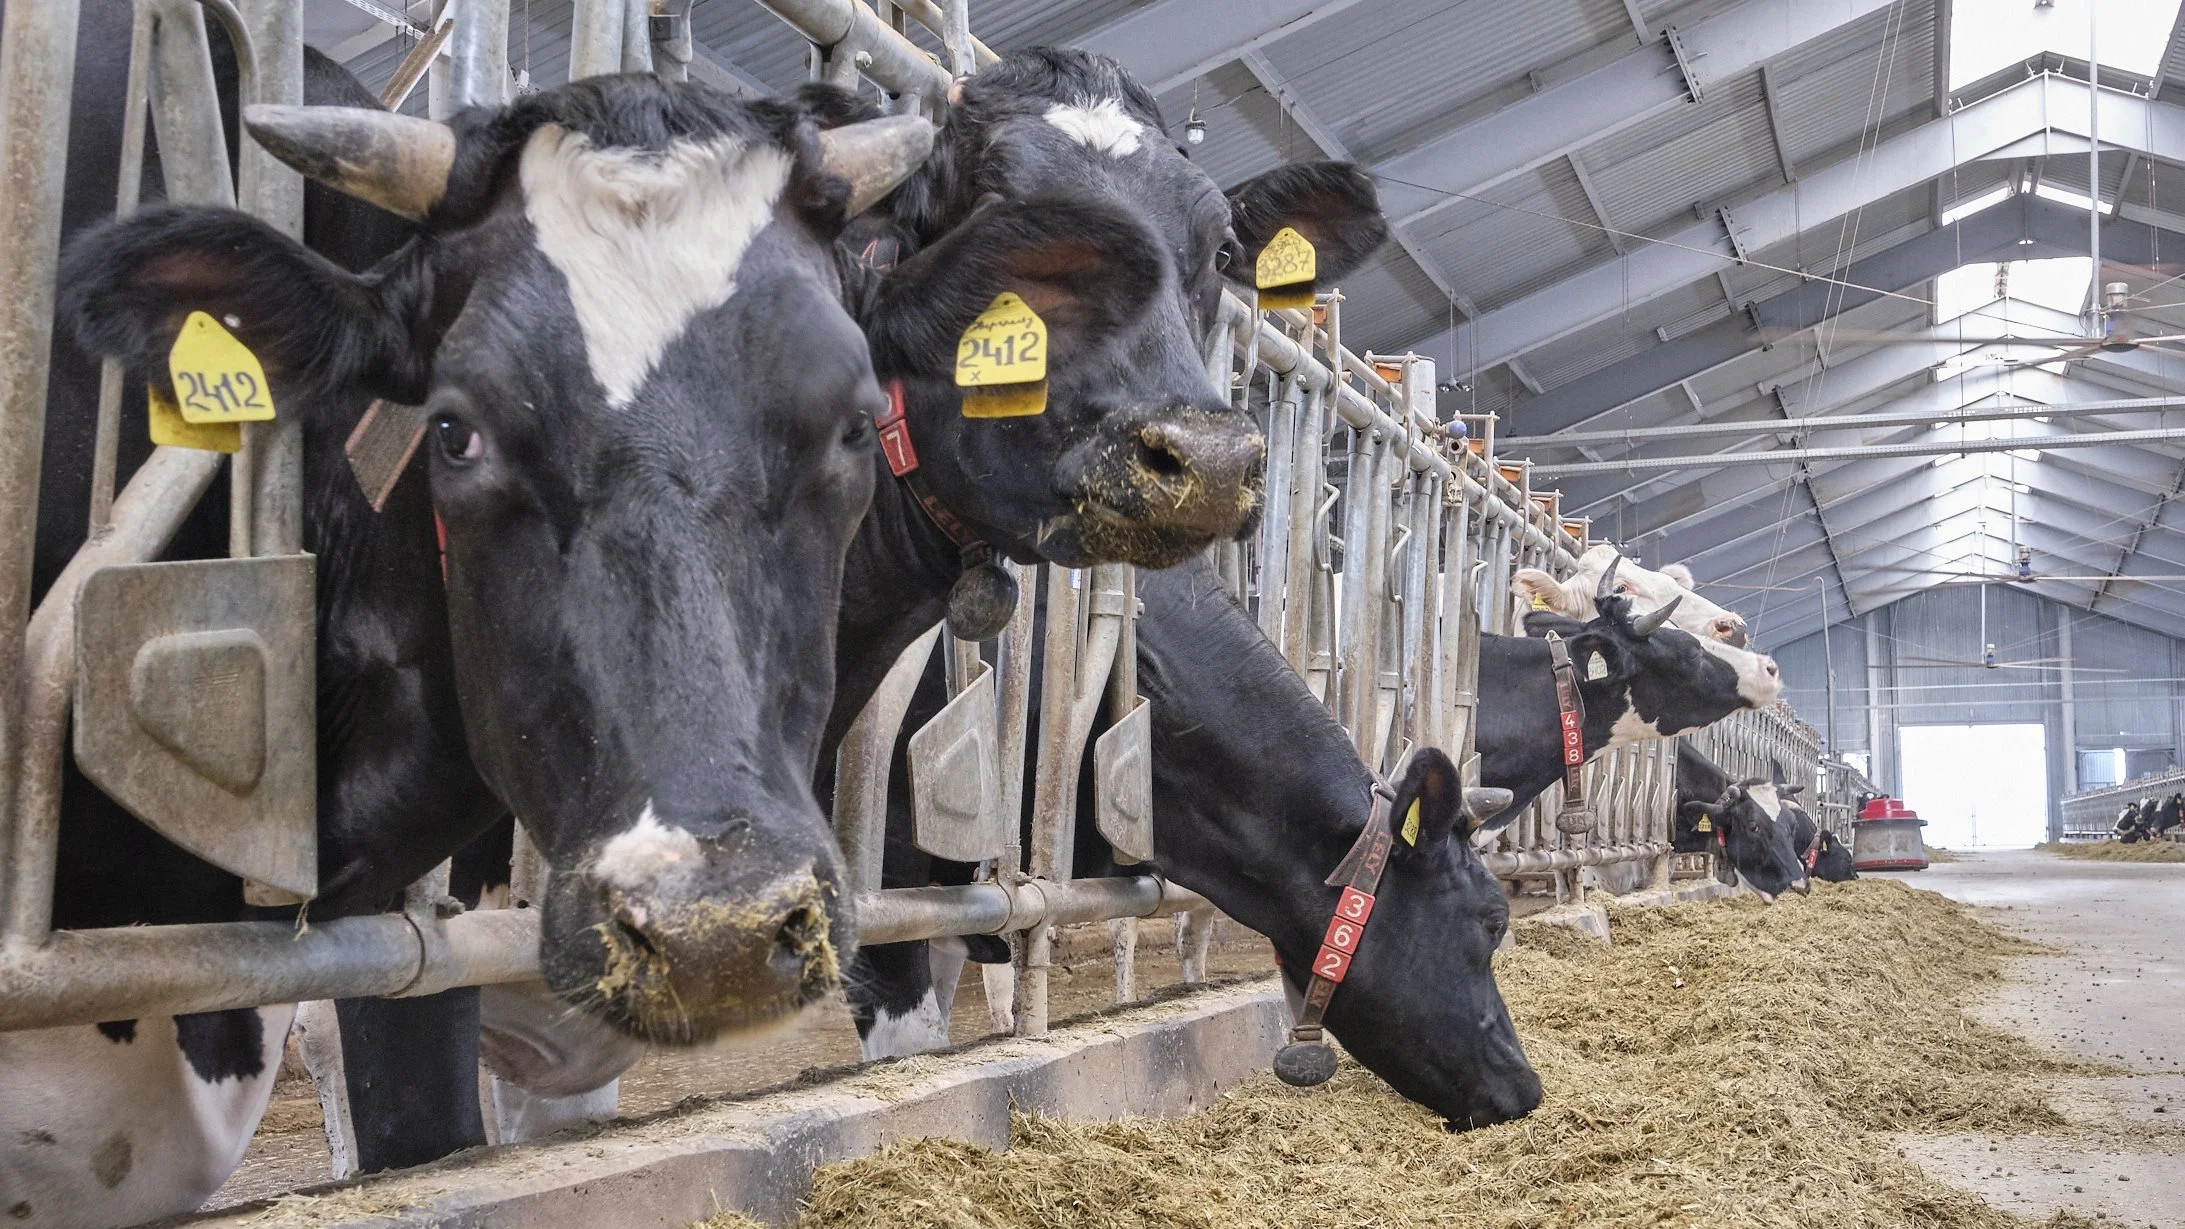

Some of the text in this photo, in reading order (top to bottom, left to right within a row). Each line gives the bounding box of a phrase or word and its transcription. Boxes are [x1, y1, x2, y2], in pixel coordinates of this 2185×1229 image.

[959, 331, 1040, 369] 2412
[178, 371, 265, 412] 2412
[1565, 714, 1579, 762] 438
[1321, 894, 1365, 977] 362
